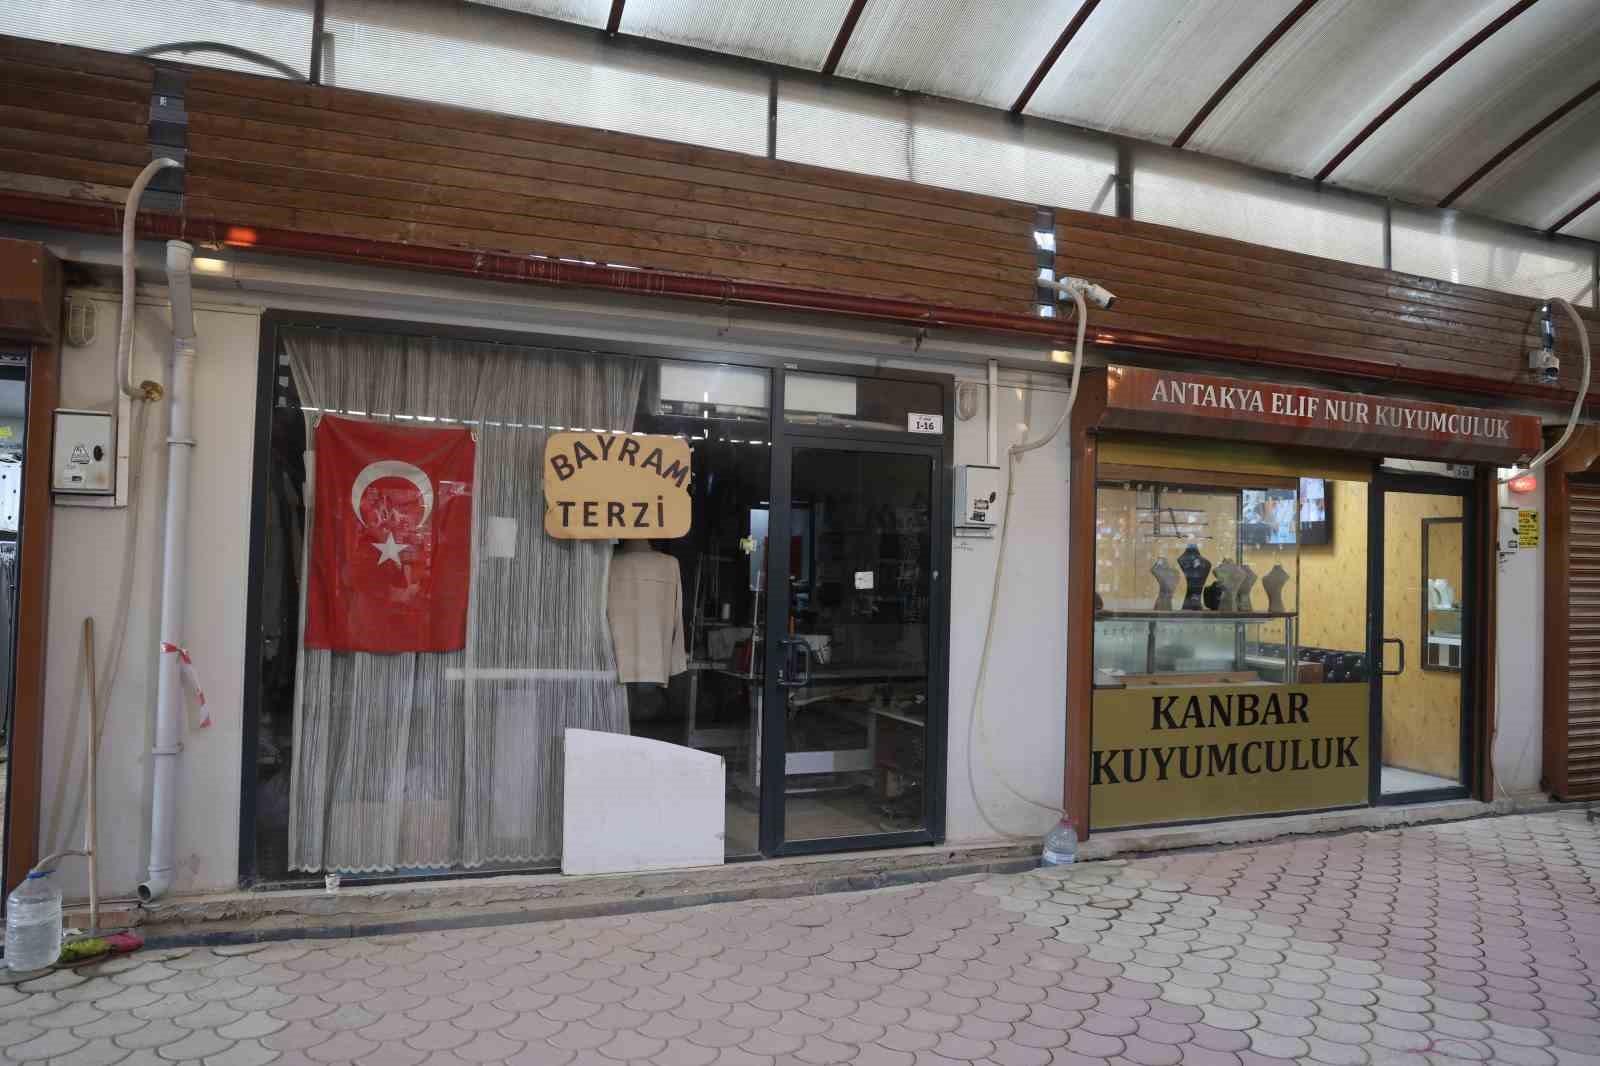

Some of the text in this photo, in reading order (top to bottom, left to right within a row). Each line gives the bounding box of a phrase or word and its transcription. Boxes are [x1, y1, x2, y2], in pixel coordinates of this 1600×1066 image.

[1151, 379, 1511, 440] ANTAKYA ELIF NUR KUYUMCULUK
[550, 434, 690, 488] BAYRAM
[556, 495, 665, 527] TERZİ
[1151, 691, 1310, 730] KANBAR
[1090, 735, 1360, 785] KUYUMCULUK
